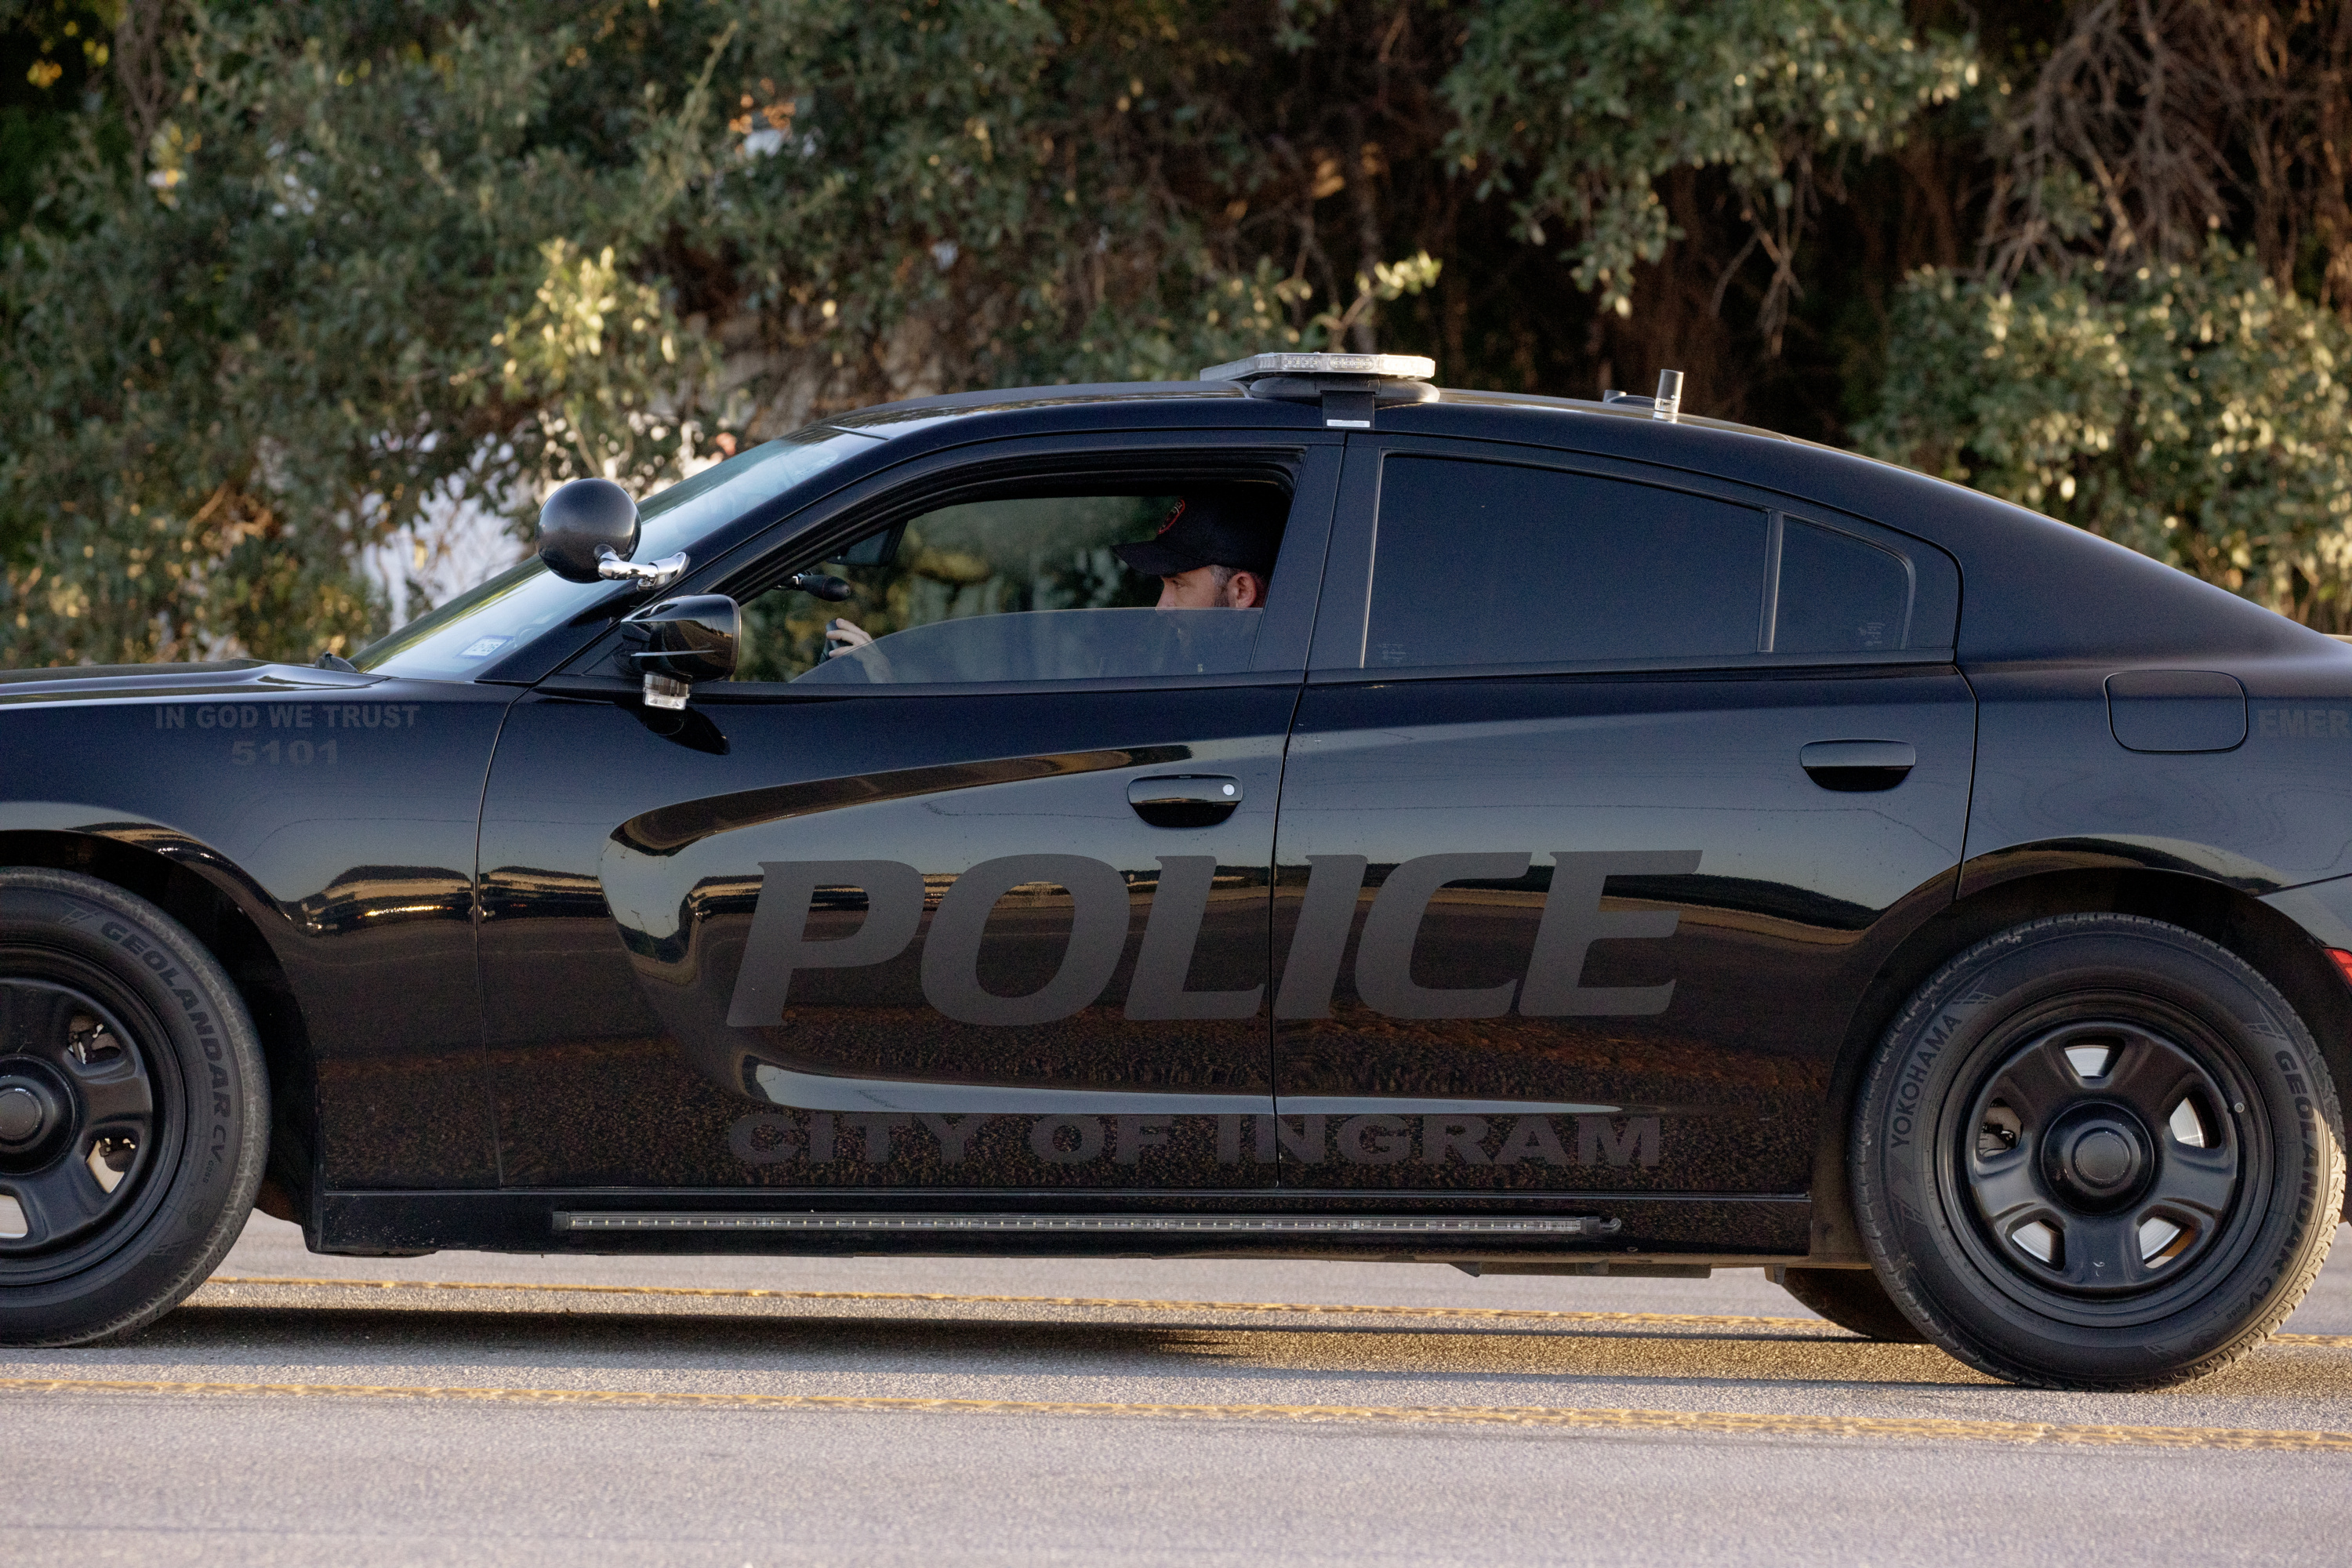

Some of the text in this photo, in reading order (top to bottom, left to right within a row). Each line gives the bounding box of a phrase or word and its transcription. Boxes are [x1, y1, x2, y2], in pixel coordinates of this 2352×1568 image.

[158, 704, 419, 729] IN GOD WE TRUST
[2258, 709, 2350, 738] EMER
[230, 739, 338, 766] 5101
[726, 850, 1703, 1026] POLICE
[100, 921, 230, 1118] GEOLANDAR
[211, 1124, 226, 1163] CV
[1890, 1014, 1962, 1149] YOKOHAMA
[727, 1112, 1661, 1167] CITY OF INGRAM
[2270, 1051, 2319, 1276] GEOLANDAR
[2249, 1276, 2273, 1312] CV
